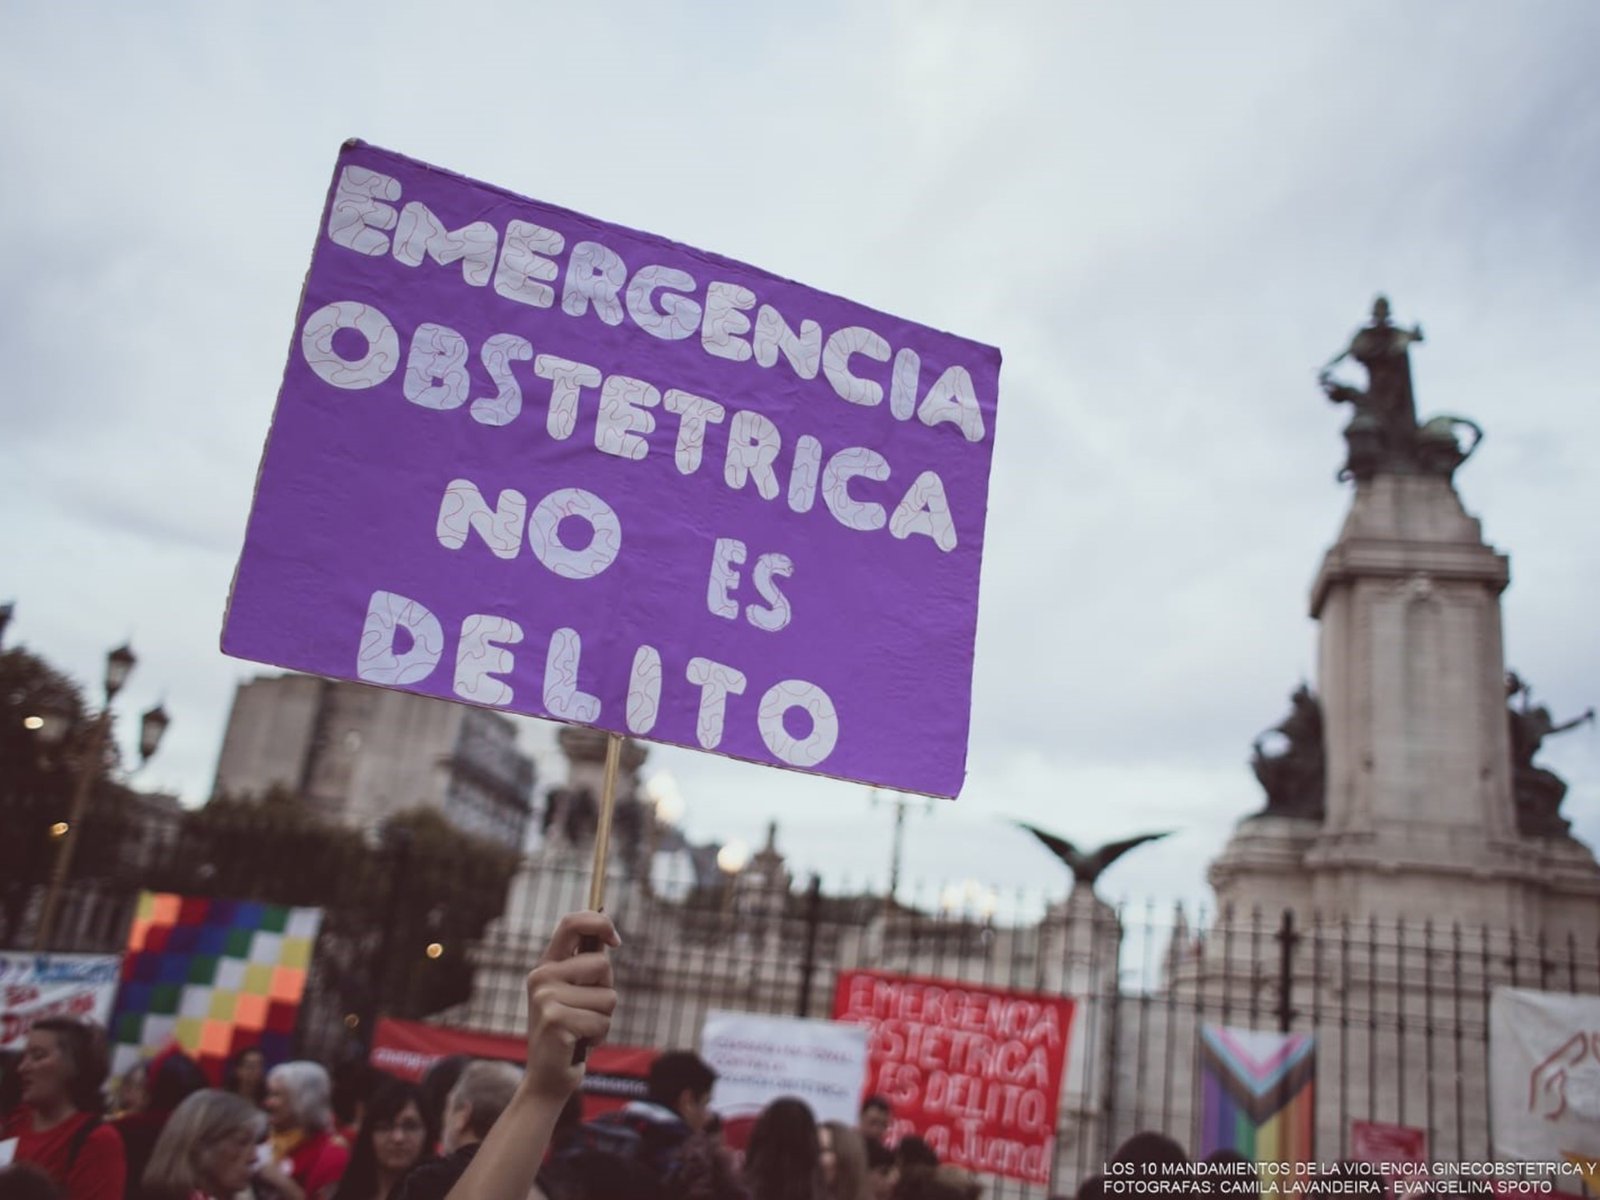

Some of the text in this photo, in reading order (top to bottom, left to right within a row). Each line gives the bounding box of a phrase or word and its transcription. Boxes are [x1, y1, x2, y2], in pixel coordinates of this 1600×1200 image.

[329, 165, 986, 442] EMERGENCIA
[302, 301, 958, 553] OBSTETRICA
[436, 478, 793, 633] NO ES
[356, 590, 839, 768] DELITO
